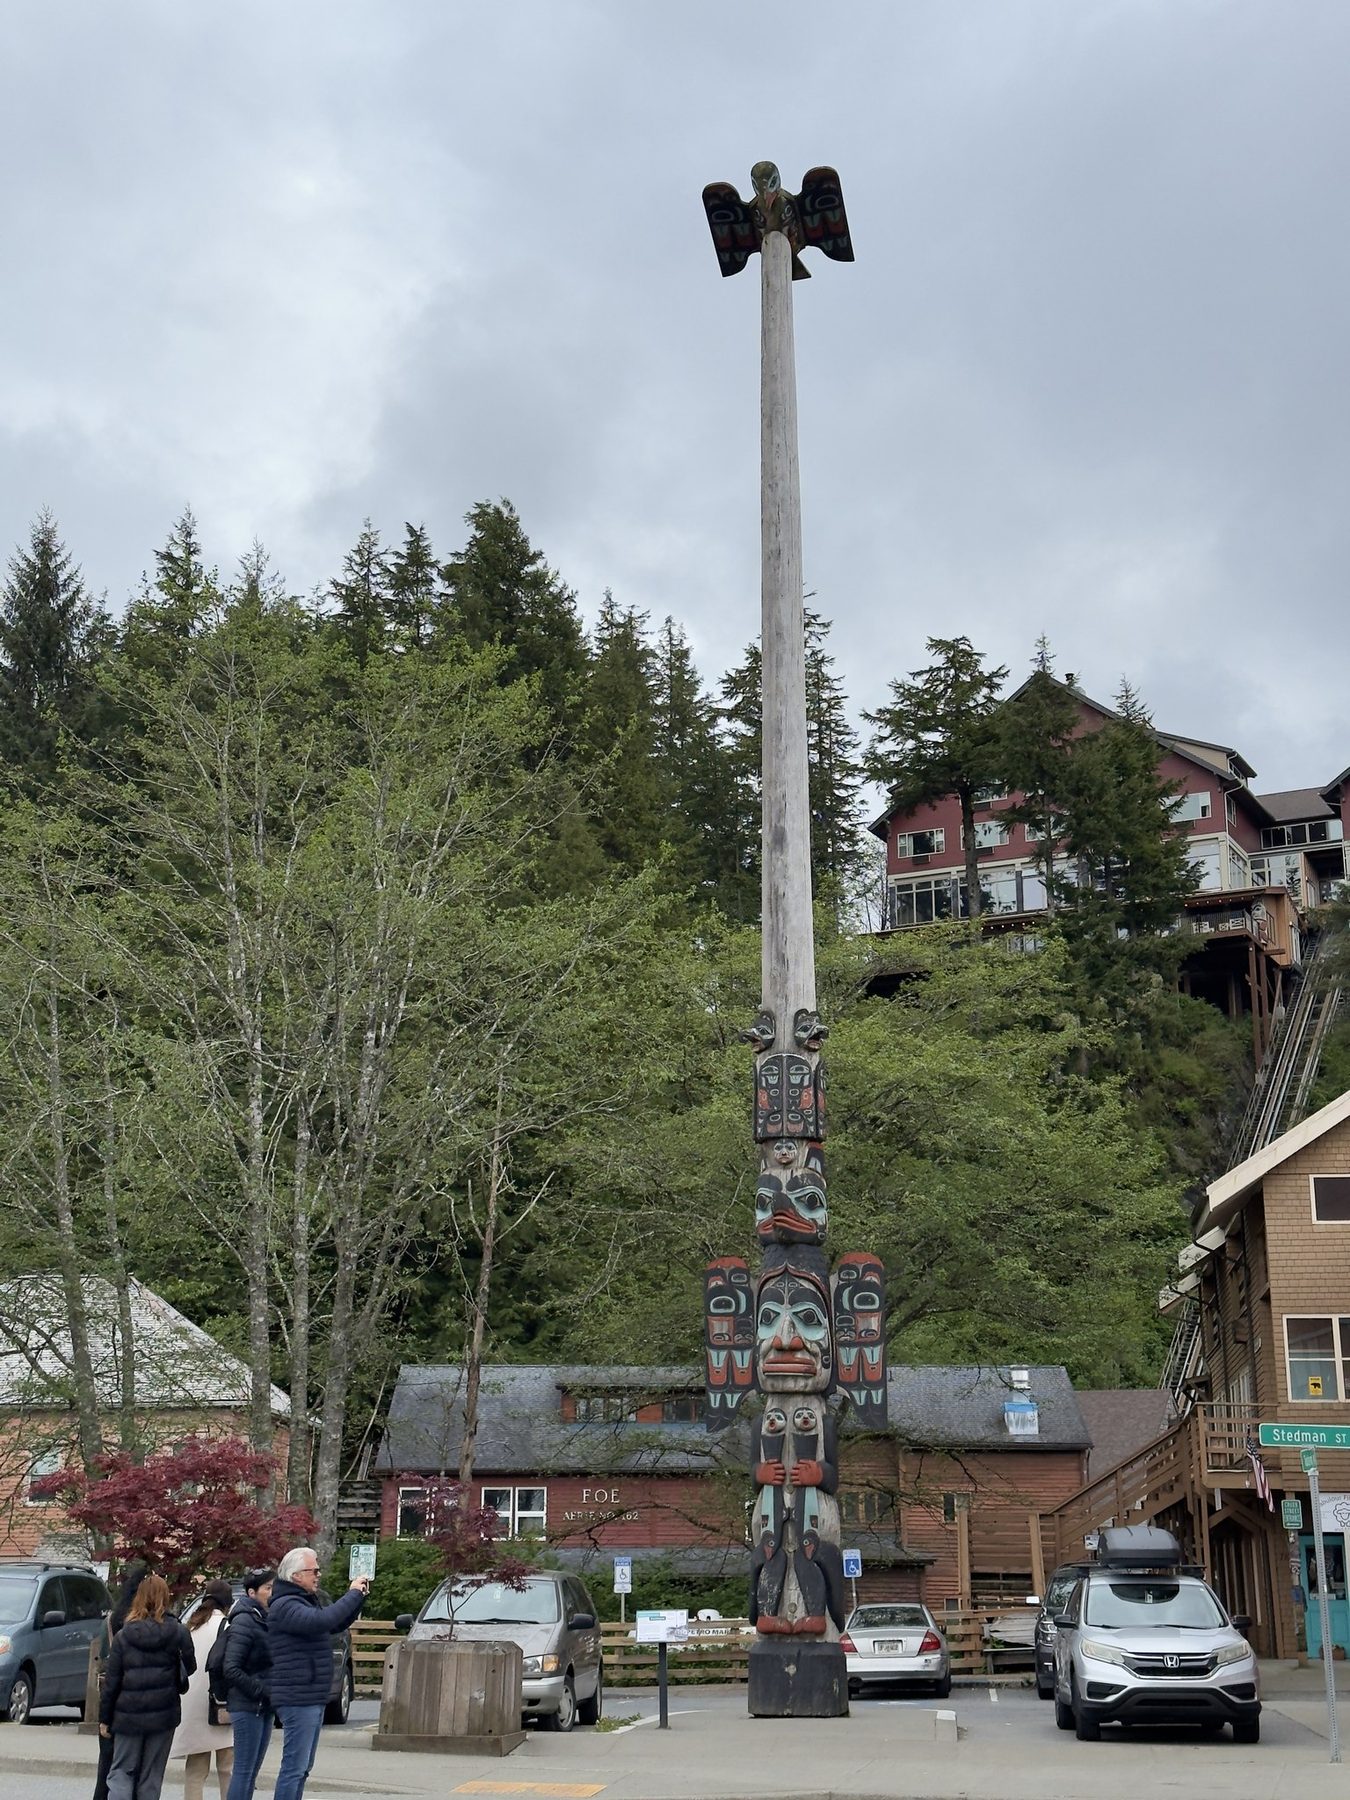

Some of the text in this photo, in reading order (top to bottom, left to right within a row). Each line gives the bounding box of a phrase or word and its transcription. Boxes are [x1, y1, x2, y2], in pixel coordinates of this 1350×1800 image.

[1273, 1428, 1346, 1443] Stedman ST
[582, 1488, 620, 1503] FOE
[352, 1546, 359, 1557] 2
